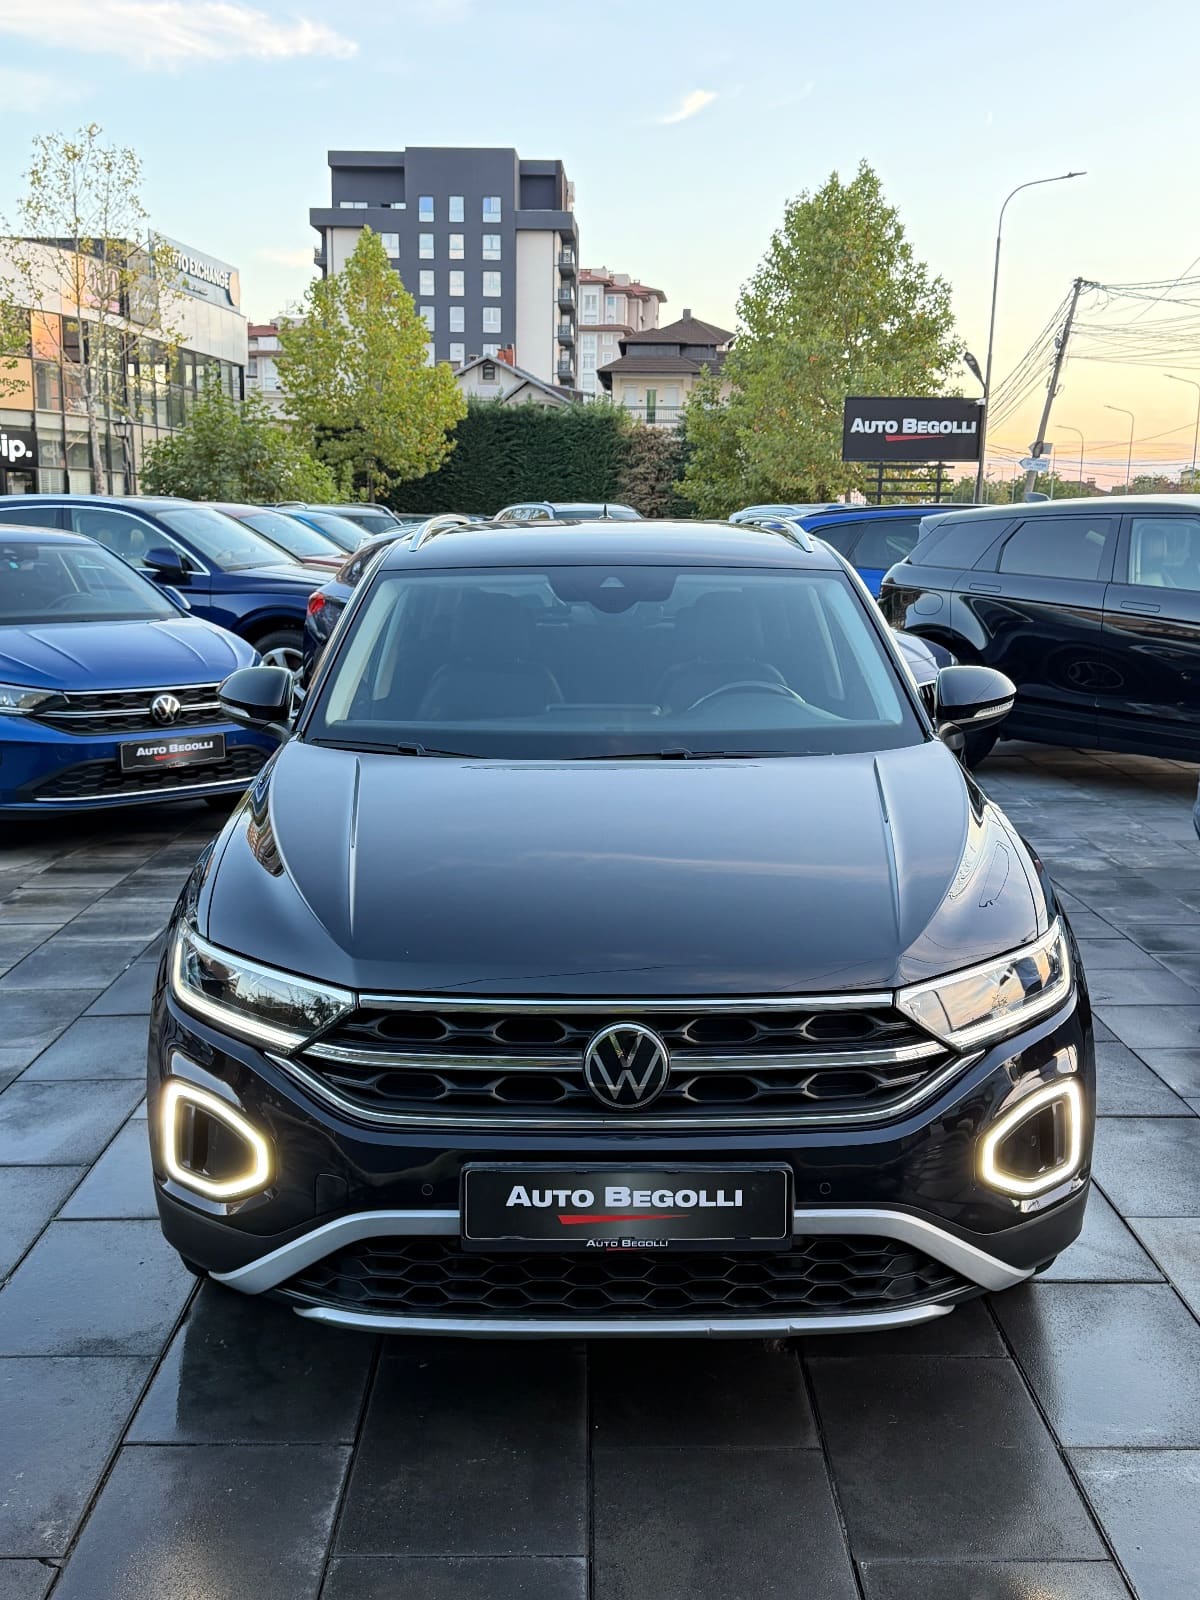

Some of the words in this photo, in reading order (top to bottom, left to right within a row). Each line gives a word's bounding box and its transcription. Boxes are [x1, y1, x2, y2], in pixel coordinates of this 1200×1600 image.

[155, 245, 189, 273] CYPTO
[189, 257, 230, 290] EXCHANGE
[850, 418, 898, 433] AUTO
[902, 418, 977, 433] BEGOLLI
[0, 433, 33, 462] ip.
[136, 746, 167, 757] AUTO
[169, 741, 214, 753] BEGOLLI
[505, 1185, 595, 1208] AUTO
[604, 1186, 743, 1208] BEGOLLI
[586, 1239, 619, 1248] AUTO
[621, 1239, 669, 1248] BEGOLLI
